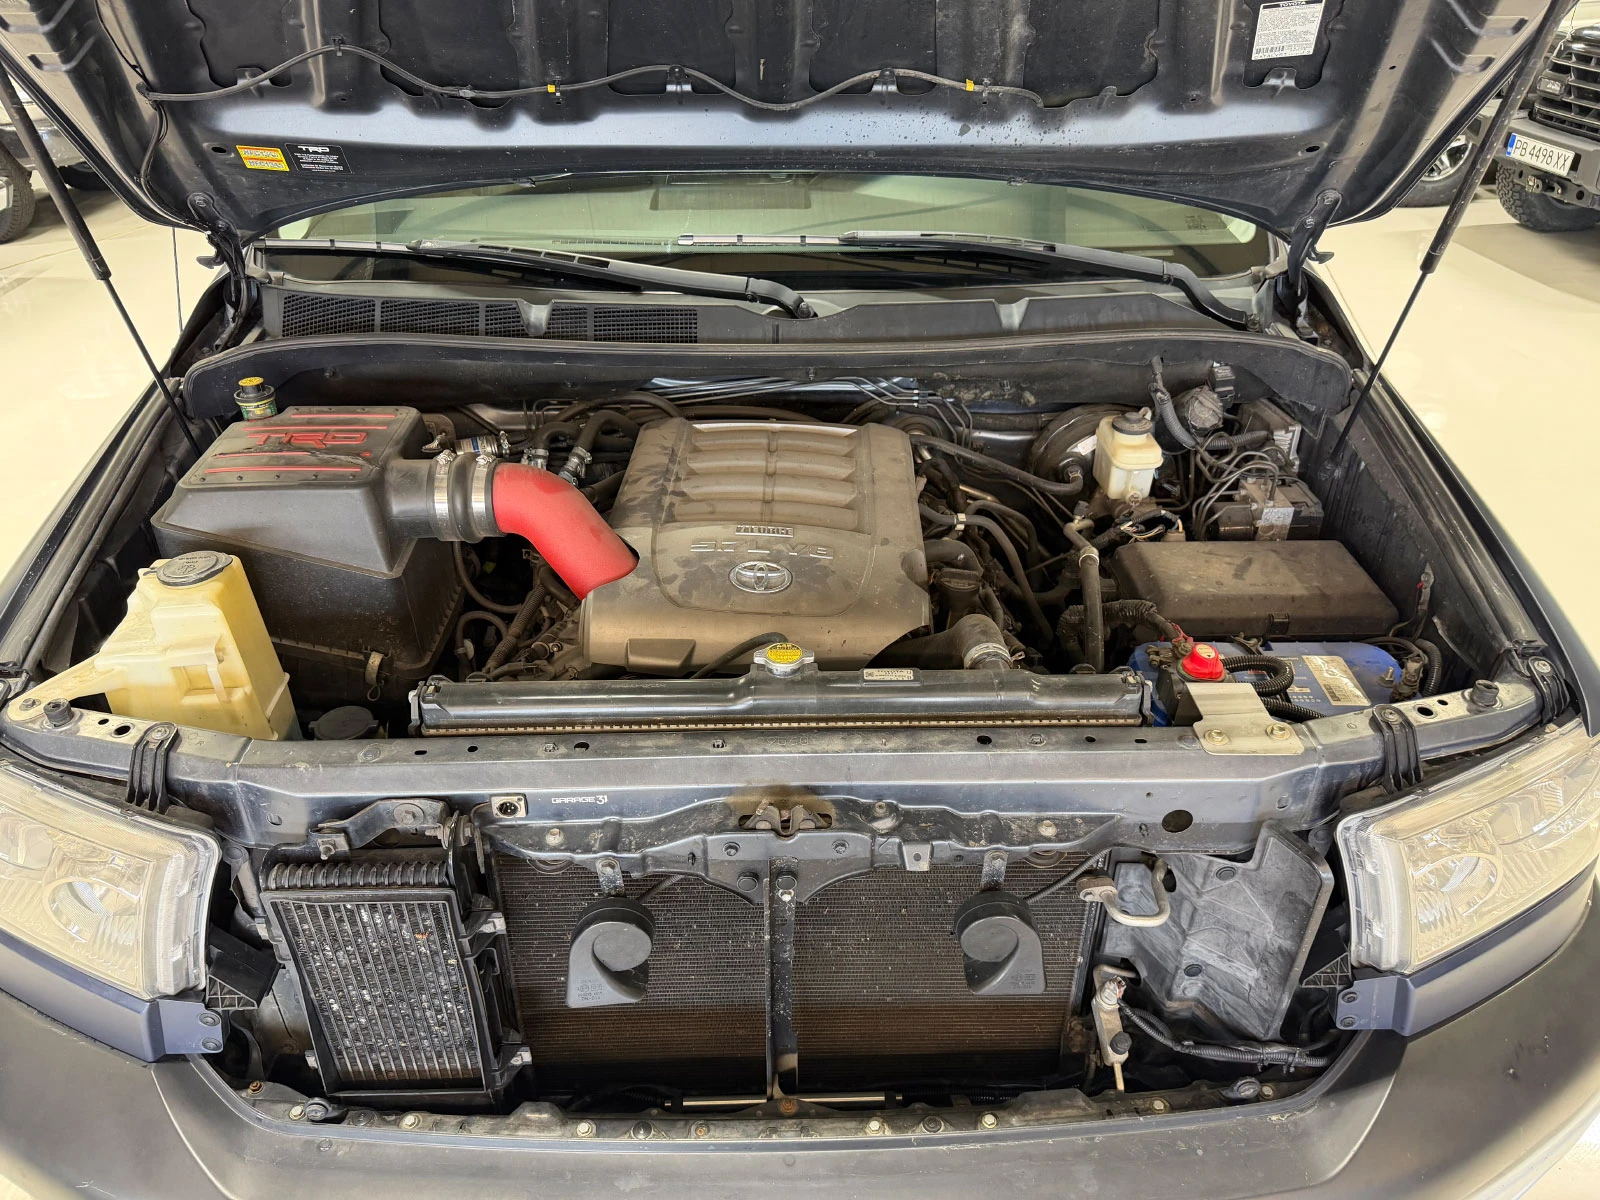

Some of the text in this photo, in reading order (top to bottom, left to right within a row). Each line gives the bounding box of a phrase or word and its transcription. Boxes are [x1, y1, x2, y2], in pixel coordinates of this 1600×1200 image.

[297, 145, 330, 153] TRD
[1513, 139, 1571, 171] PB 4498 XX
[247, 432, 368, 449] TRD
[551, 794, 609, 805] GARAGE 31
